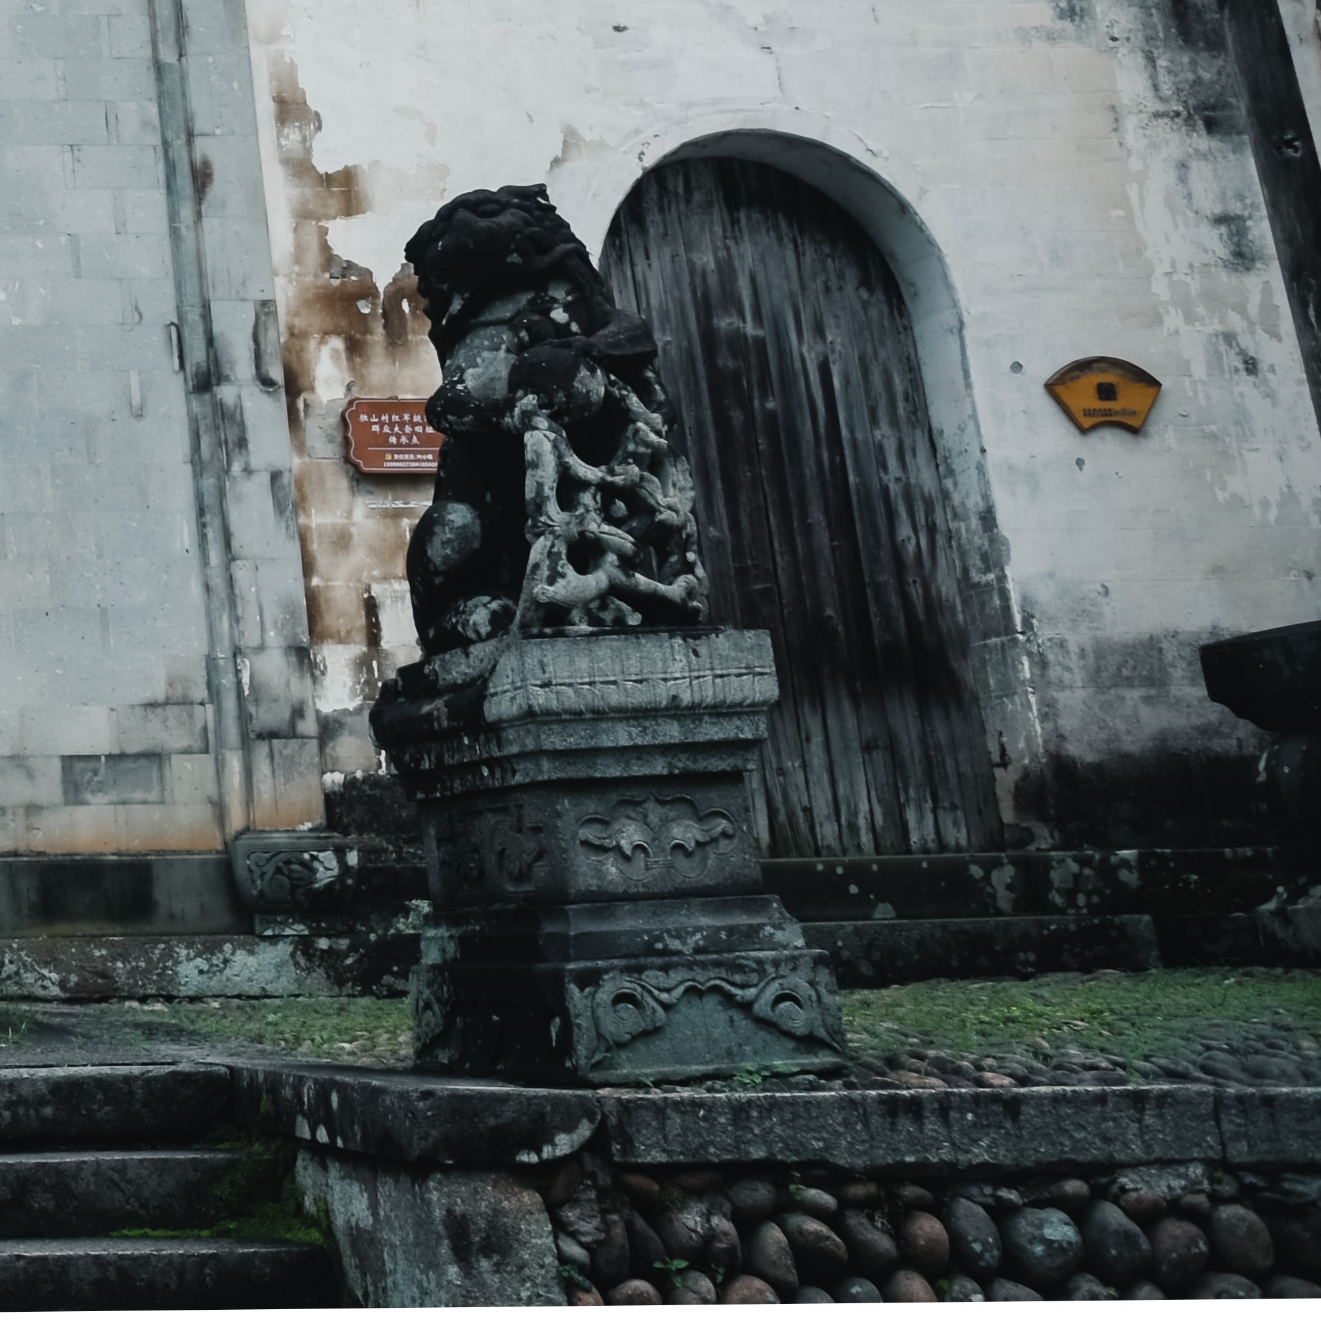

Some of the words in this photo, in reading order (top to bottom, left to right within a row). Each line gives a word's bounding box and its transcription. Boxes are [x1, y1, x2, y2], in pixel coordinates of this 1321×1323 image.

[359, 413, 428, 423] 独山村红军挺
